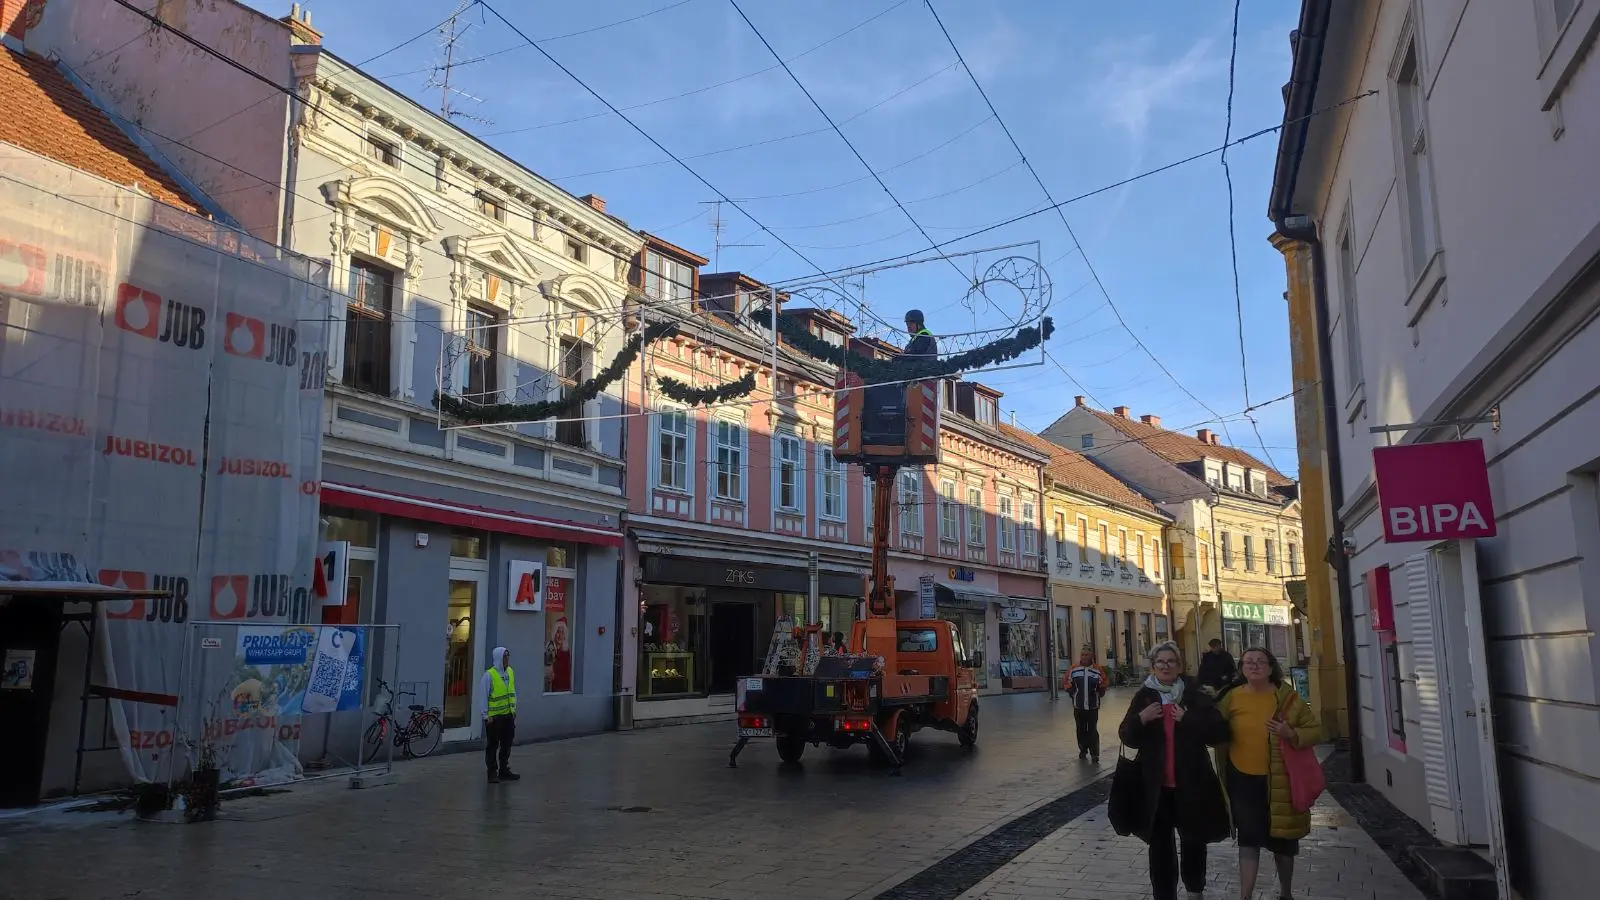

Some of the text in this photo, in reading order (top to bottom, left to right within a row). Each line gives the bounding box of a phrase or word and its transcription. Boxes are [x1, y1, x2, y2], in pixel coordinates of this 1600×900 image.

[160, 300, 206, 350] JUB
[265, 323, 297, 367] JUB
[103, 435, 197, 466] JUBIZOL
[217, 456, 292, 478] JUBIZOL
[1389, 501, 1489, 536] BIPA
[515, 568, 541, 604] A1
[725, 569, 755, 583] ZAKS
[146, 574, 190, 624] JUB
[246, 574, 288, 618] JUB
[1222, 603, 1261, 619] MODA
